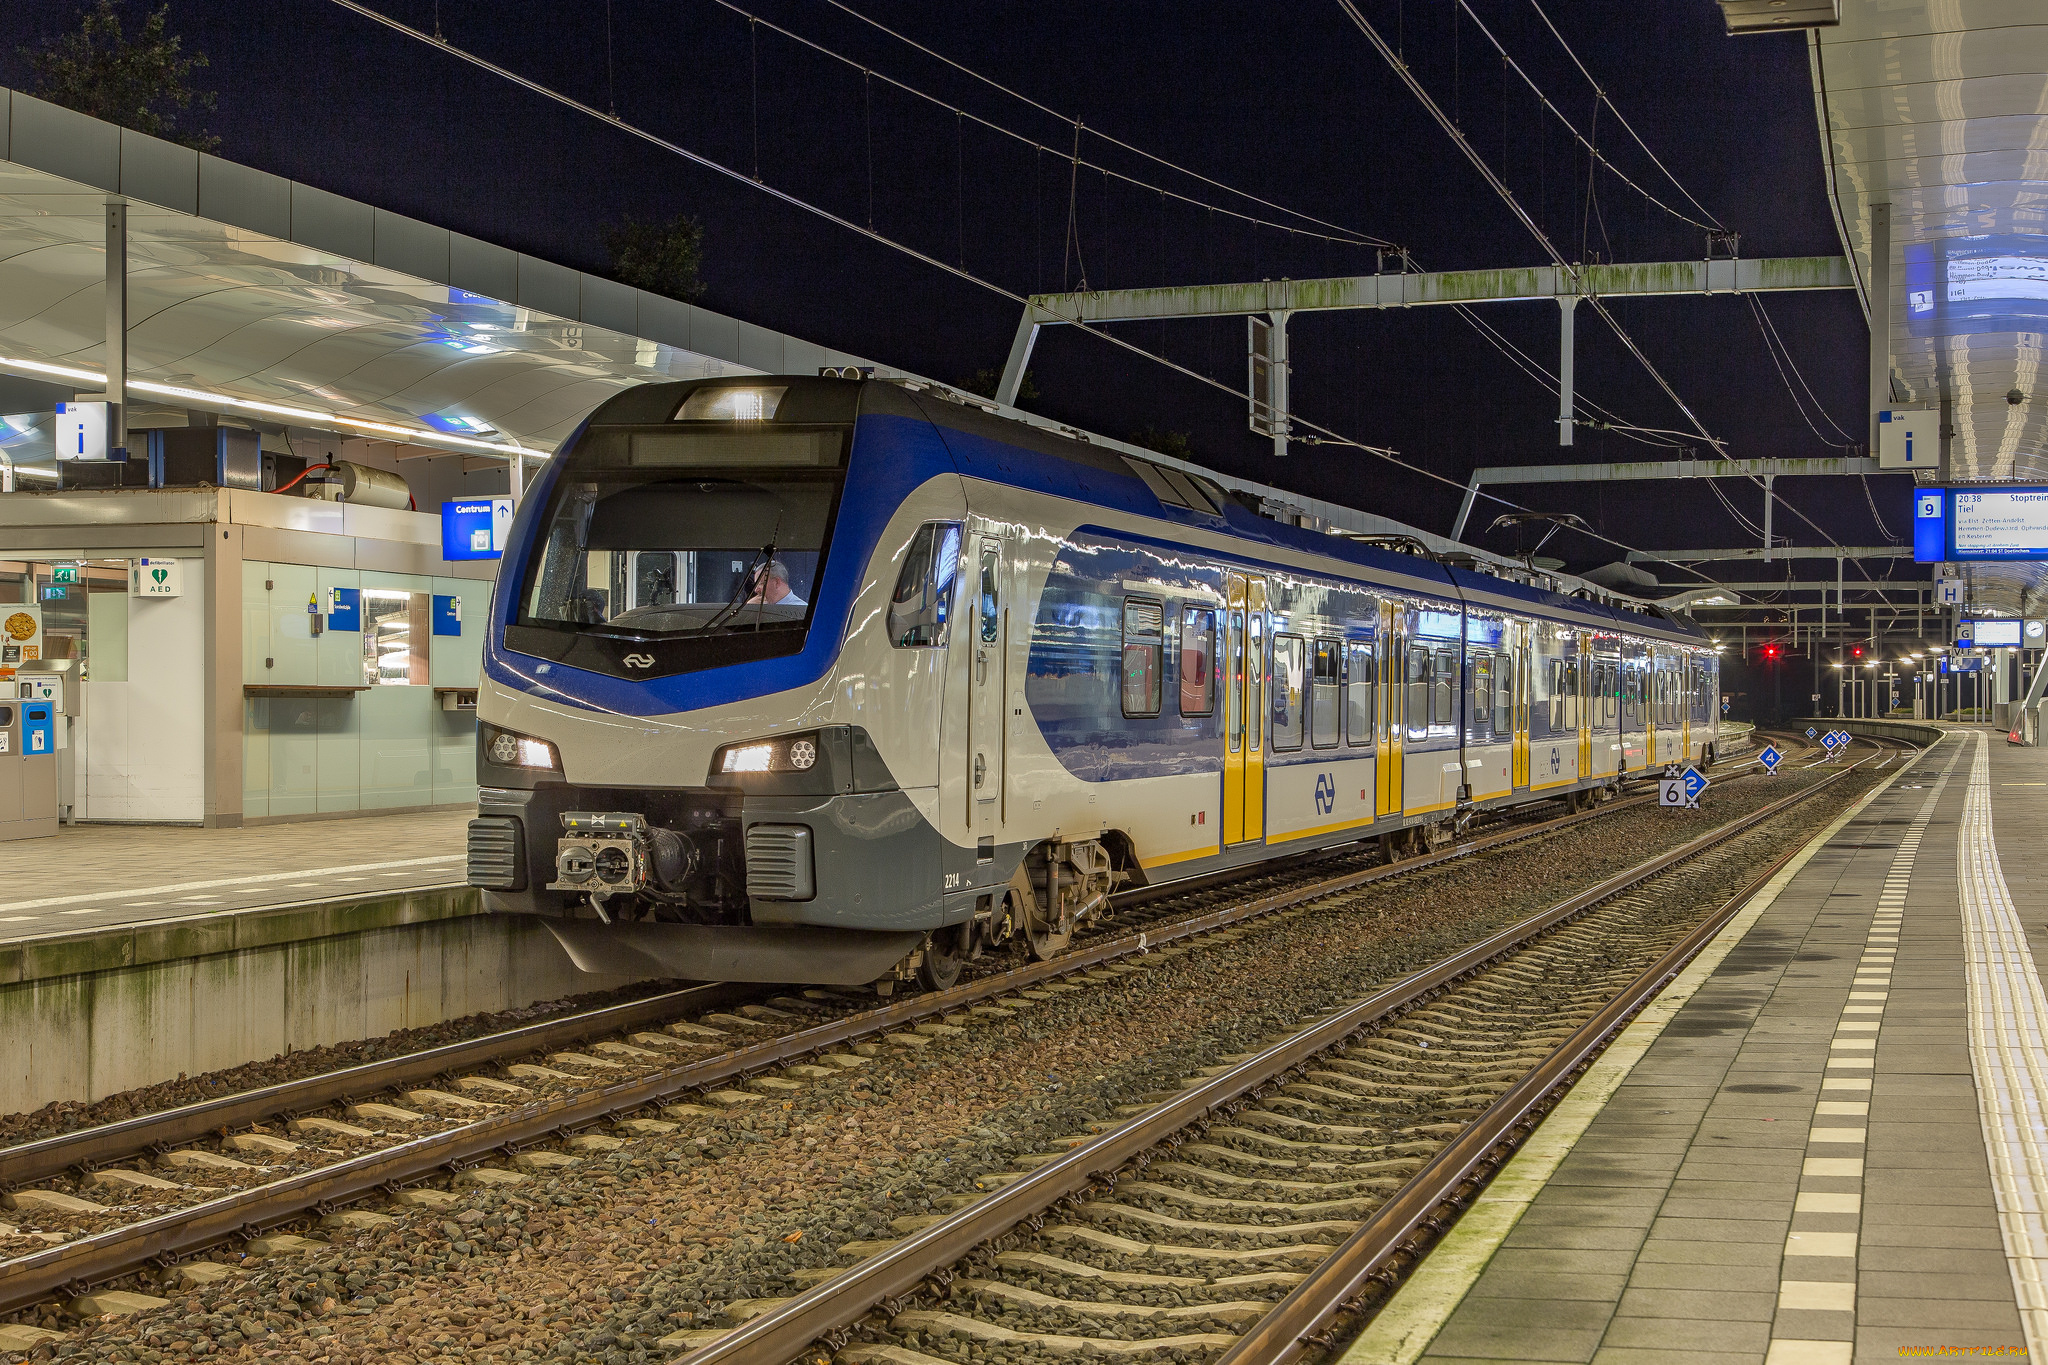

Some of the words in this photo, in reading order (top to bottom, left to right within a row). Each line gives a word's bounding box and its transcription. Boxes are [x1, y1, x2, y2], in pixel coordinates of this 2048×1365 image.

[1958, 495, 1982, 503] 20:38
[455, 505, 491, 514] Centrum
[1925, 504, 1934, 515] 9
[1958, 504, 1974, 513] Tiel
[1945, 588, 1956, 601] H
[1961, 630, 1970, 639] G
[1826, 737, 1834, 745] 6
[1841, 734, 1847, 742] 8
[1765, 752, 1775, 763] 4
[1686, 776, 1698, 791] 2
[1666, 783, 1679, 803] 6
[945, 872, 960, 888] 2214
